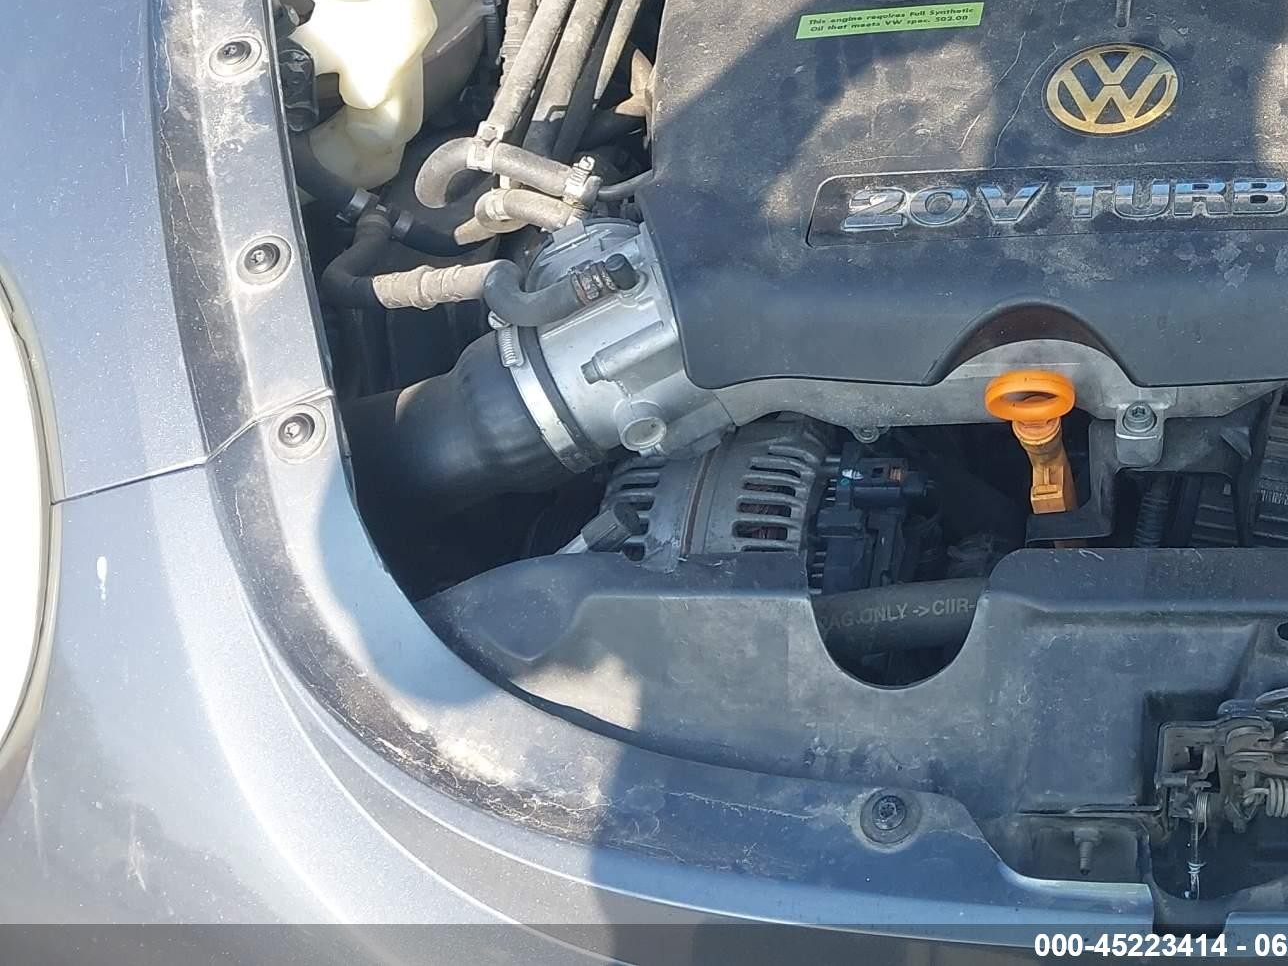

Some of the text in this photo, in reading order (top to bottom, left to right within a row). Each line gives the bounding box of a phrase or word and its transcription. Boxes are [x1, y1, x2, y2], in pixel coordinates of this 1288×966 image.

[831, 16, 863, 25] engine
[867, 12, 905, 22] requires
[929, 7, 975, 17] Synthetic
[885, 18, 904, 26] VW
[907, 17, 930, 26] spec.
[842, 182, 1048, 231] 20V
